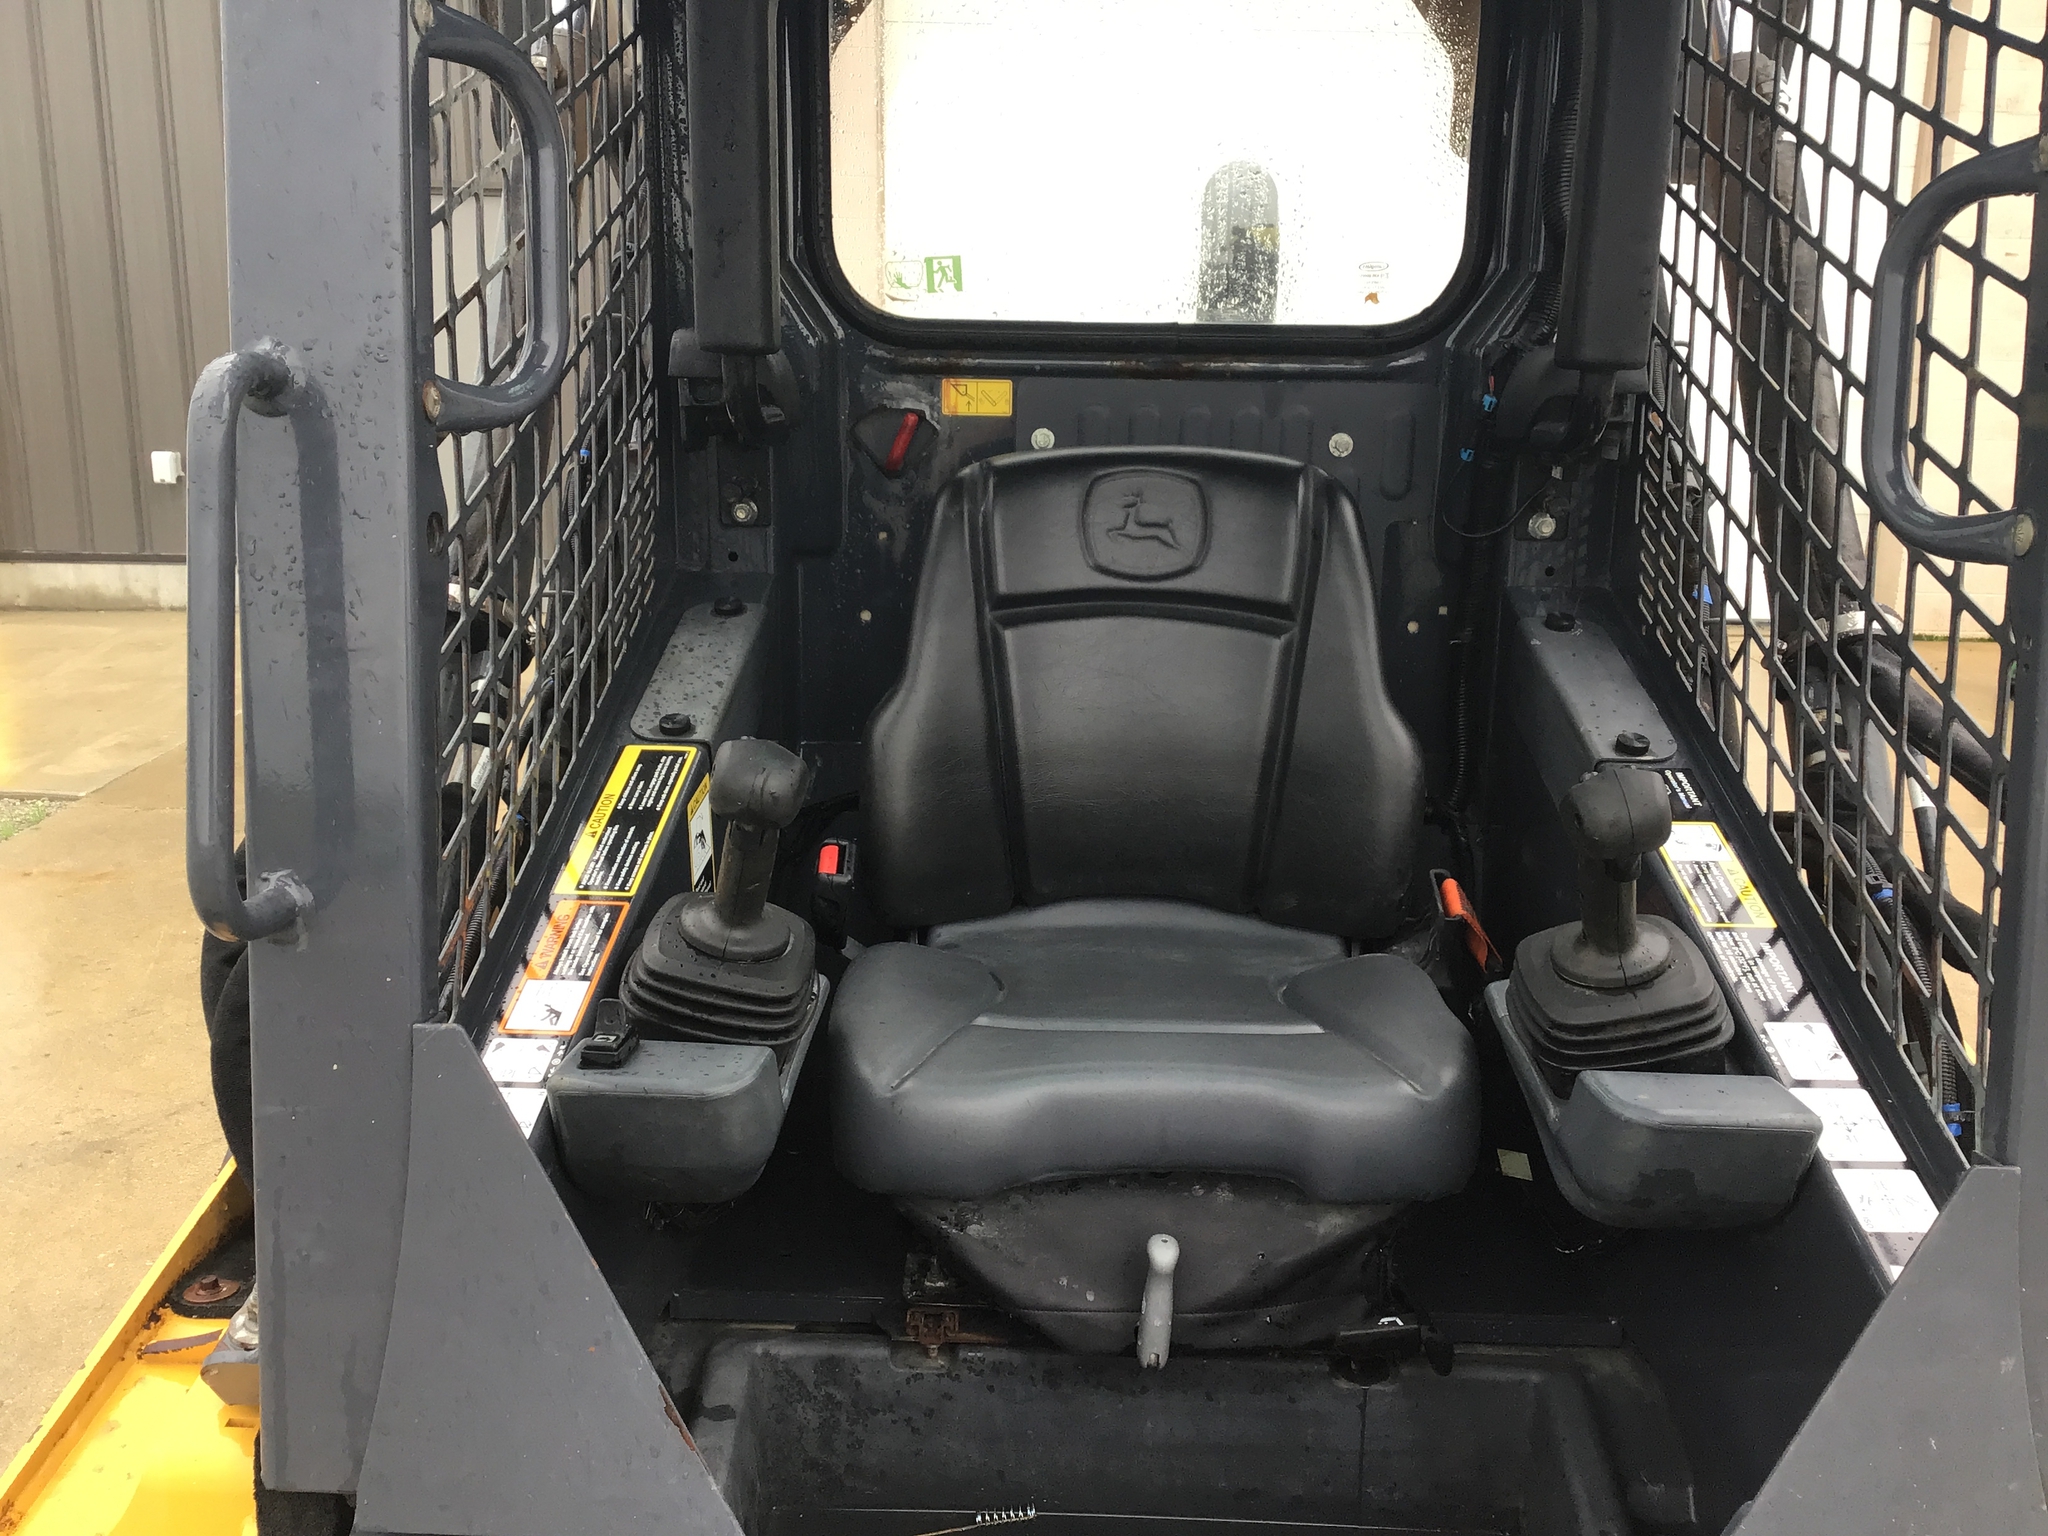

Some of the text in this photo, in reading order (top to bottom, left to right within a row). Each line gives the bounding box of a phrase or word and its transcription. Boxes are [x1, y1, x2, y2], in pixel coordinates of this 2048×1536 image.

[1676, 772, 1702, 806] IMPORTANT
[588, 794, 616, 828] CAUTION
[1733, 879, 1765, 918] CAUTION
[540, 914, 570, 958] WARNING
[1760, 943, 1797, 993] IMPORTANT
